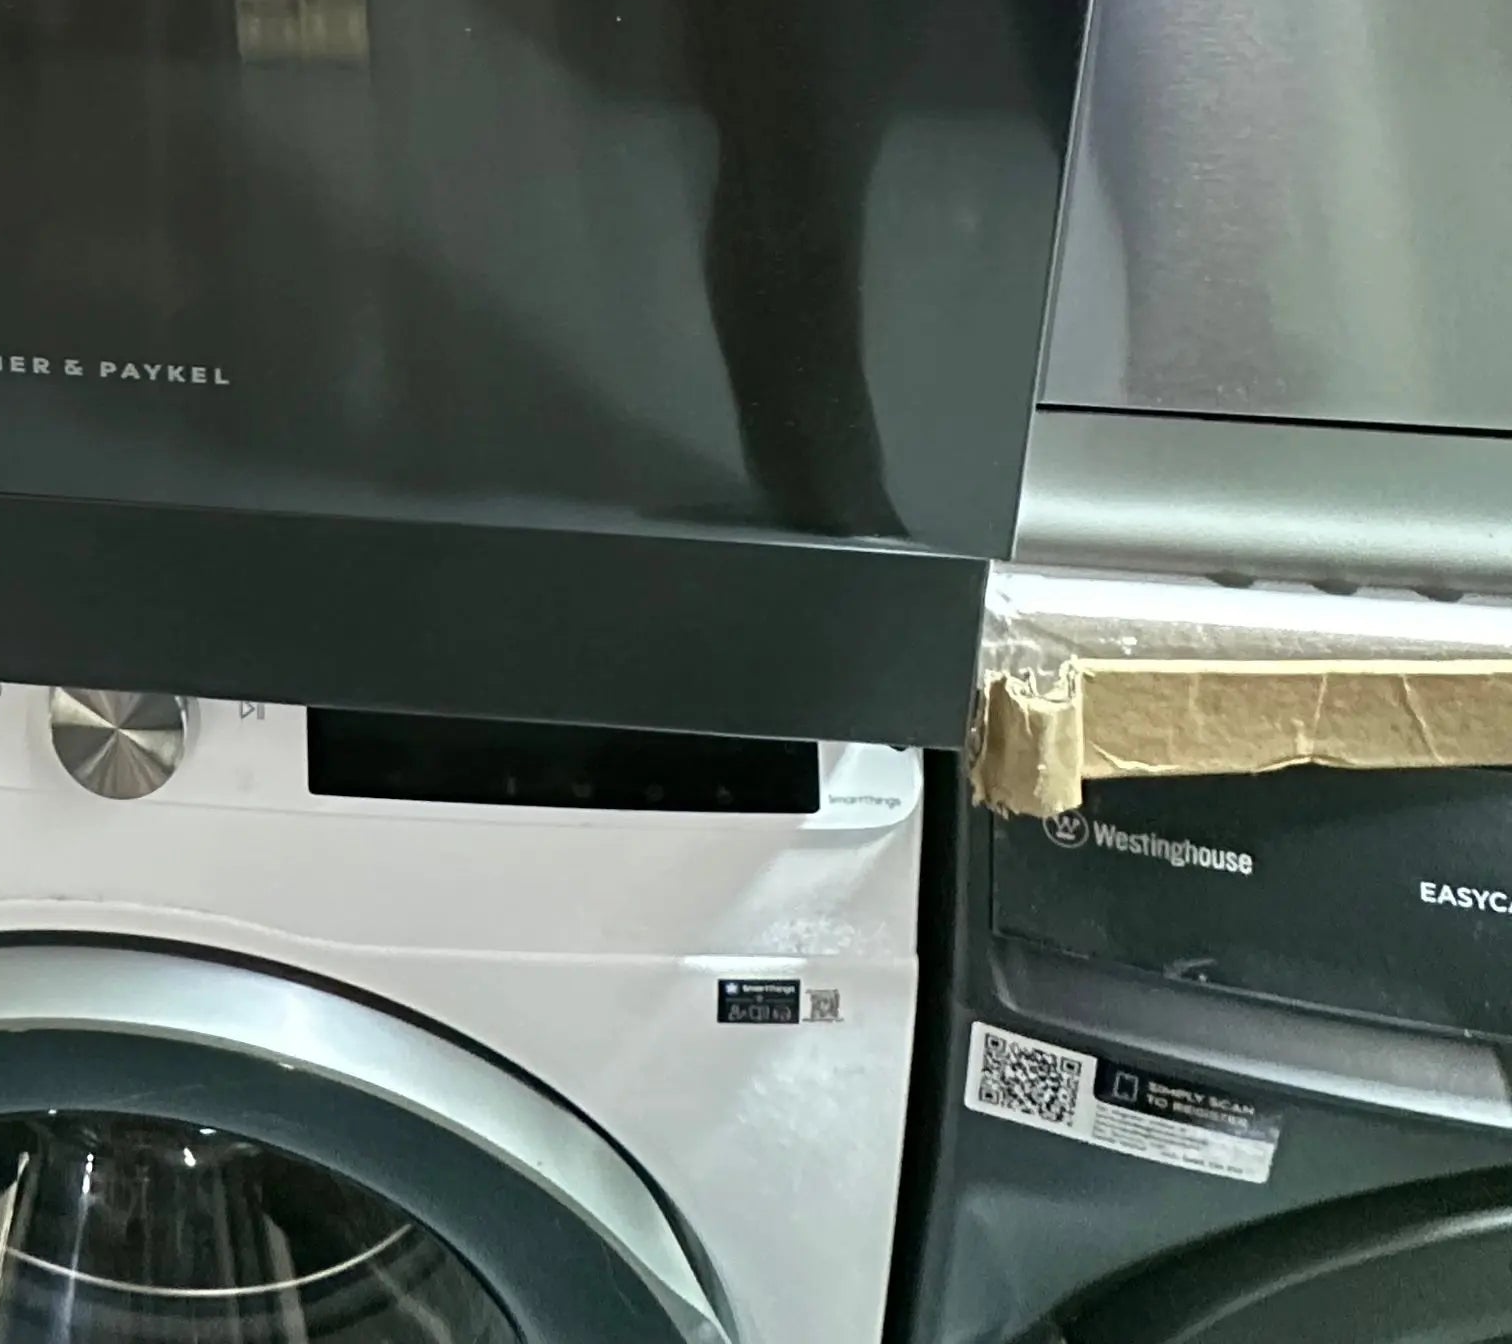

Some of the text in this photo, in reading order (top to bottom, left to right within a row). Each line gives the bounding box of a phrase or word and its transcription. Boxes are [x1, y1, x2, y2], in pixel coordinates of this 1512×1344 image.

[64, 359, 84, 376] &
[99, 360, 230, 385] PAYKEL
[1092, 820, 1254, 875] Westinghouse
[1419, 880, 1512, 914] EASYC
